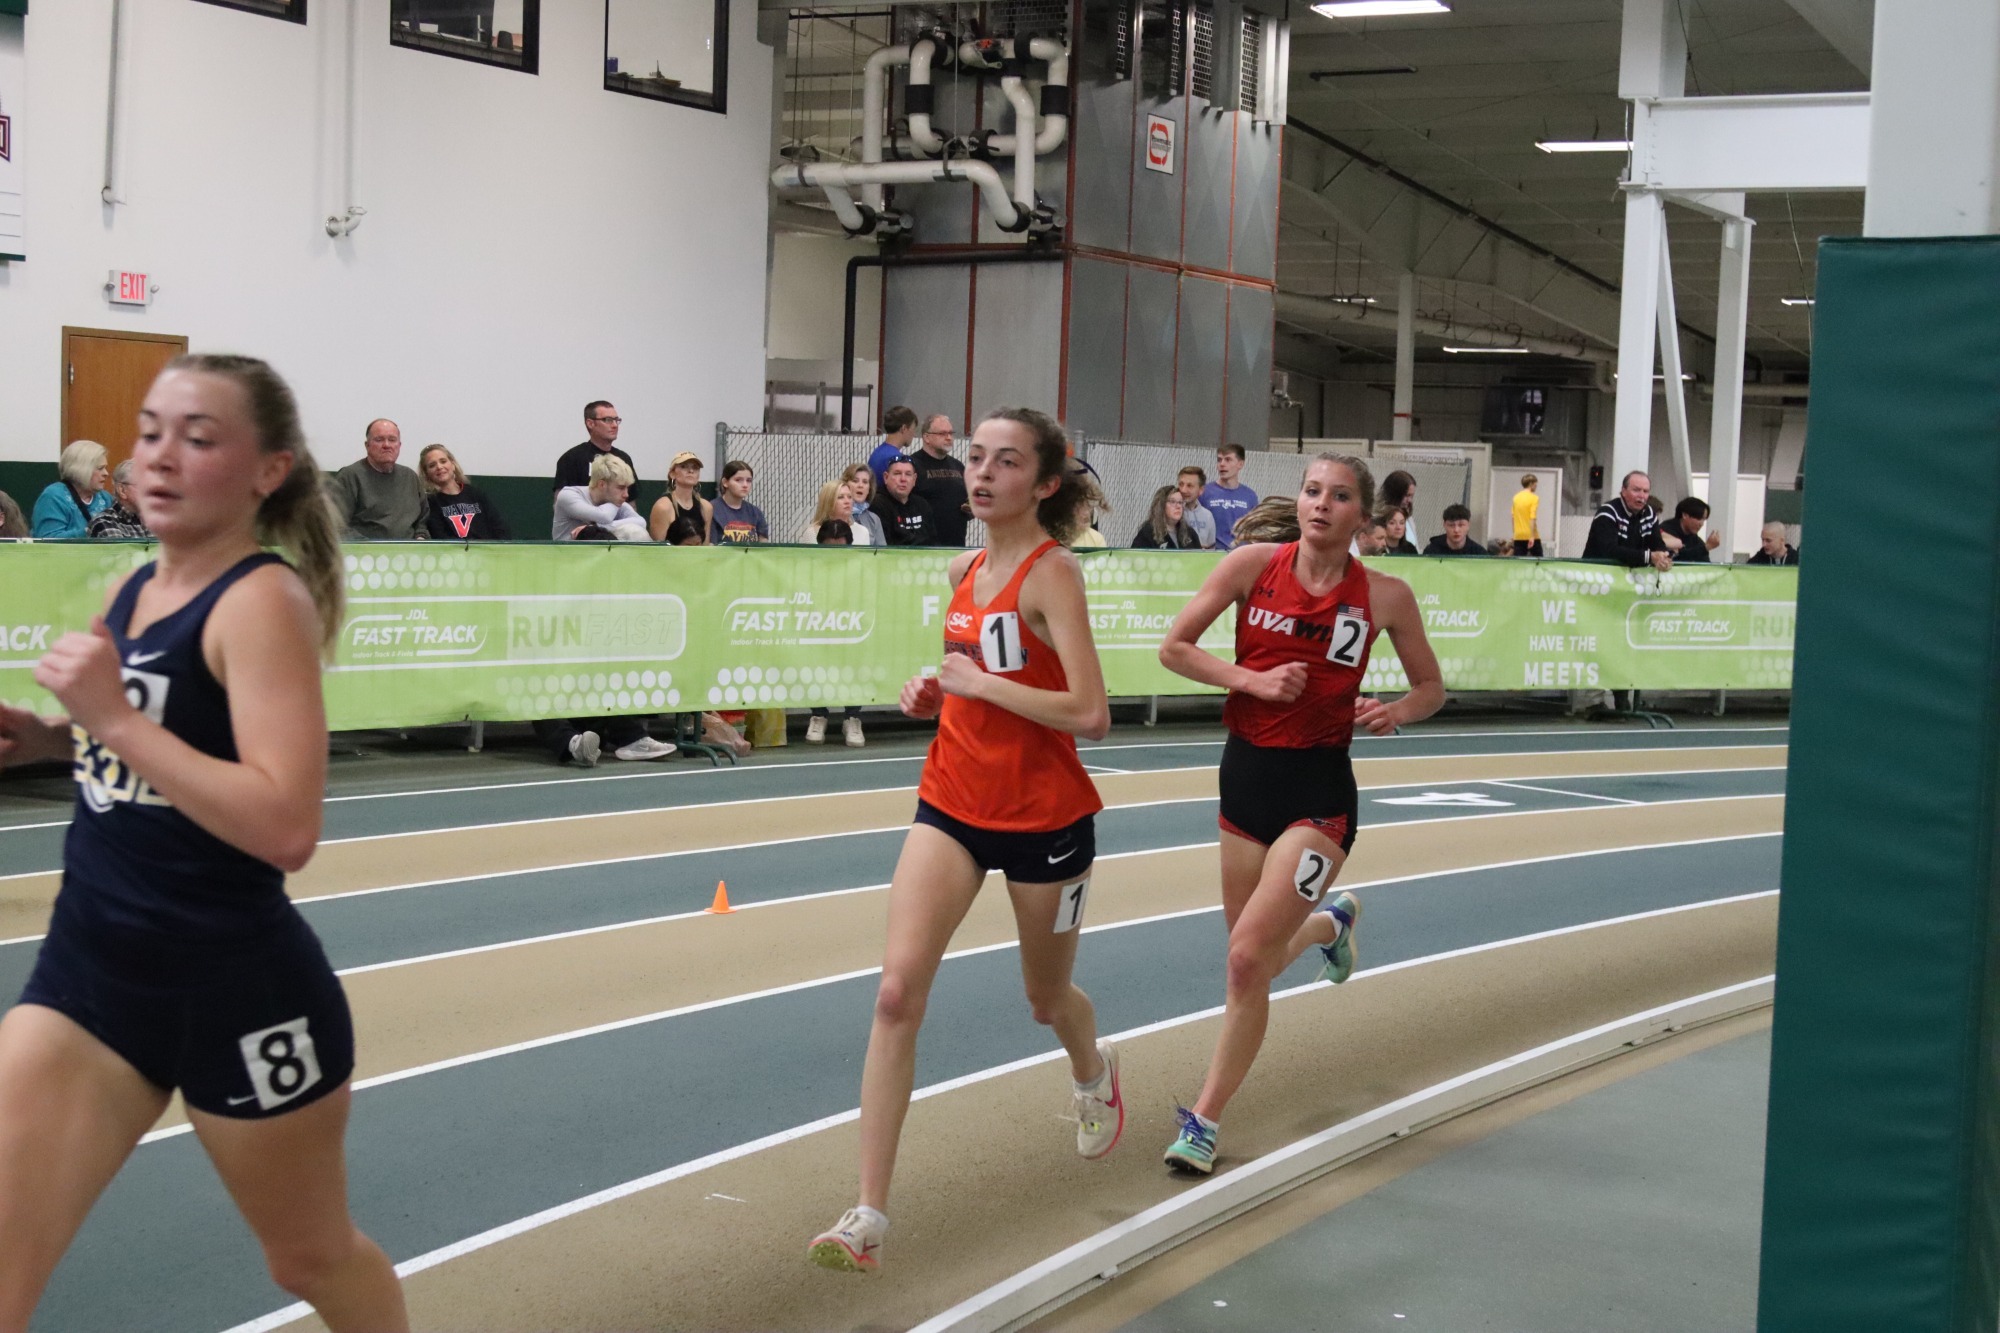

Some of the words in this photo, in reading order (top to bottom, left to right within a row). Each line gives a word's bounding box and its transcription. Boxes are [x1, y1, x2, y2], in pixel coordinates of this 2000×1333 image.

[121, 272, 147, 301] EXIT
[448, 513, 475, 538] V
[788, 592, 814, 605] JDL
[1120, 600, 1137, 610] JDL
[1422, 594, 1441, 605] JDL
[405, 609, 429, 621] JDL
[731, 611, 789, 632] FAST
[794, 611, 865, 631] TRACK
[949, 612, 973, 629] SAC
[1089, 614, 1121, 629] AST
[1125, 614, 1176, 629] TRACK
[1426, 610, 1480, 627] TRACK
[1542, 599, 1577, 624] WE
[1682, 608, 1698, 617] JDL
[1247, 606, 1334, 643] UVAWI
[1649, 620, 1683, 633] FAST
[1686, 620, 1730, 633] TRACK
[352, 626, 407, 646] FAST
[412, 625, 478, 644] TRACK
[989, 616, 1008, 668] 1
[1334, 620, 1361, 663] 2
[1529, 635, 1564, 652] HAVE
[1569, 635, 1597, 652] THE
[1524, 661, 1600, 686] MEETS
[1299, 854, 1324, 898] 2
[1070, 883, 1084, 926] 1
[259, 1031, 307, 1097] 8
